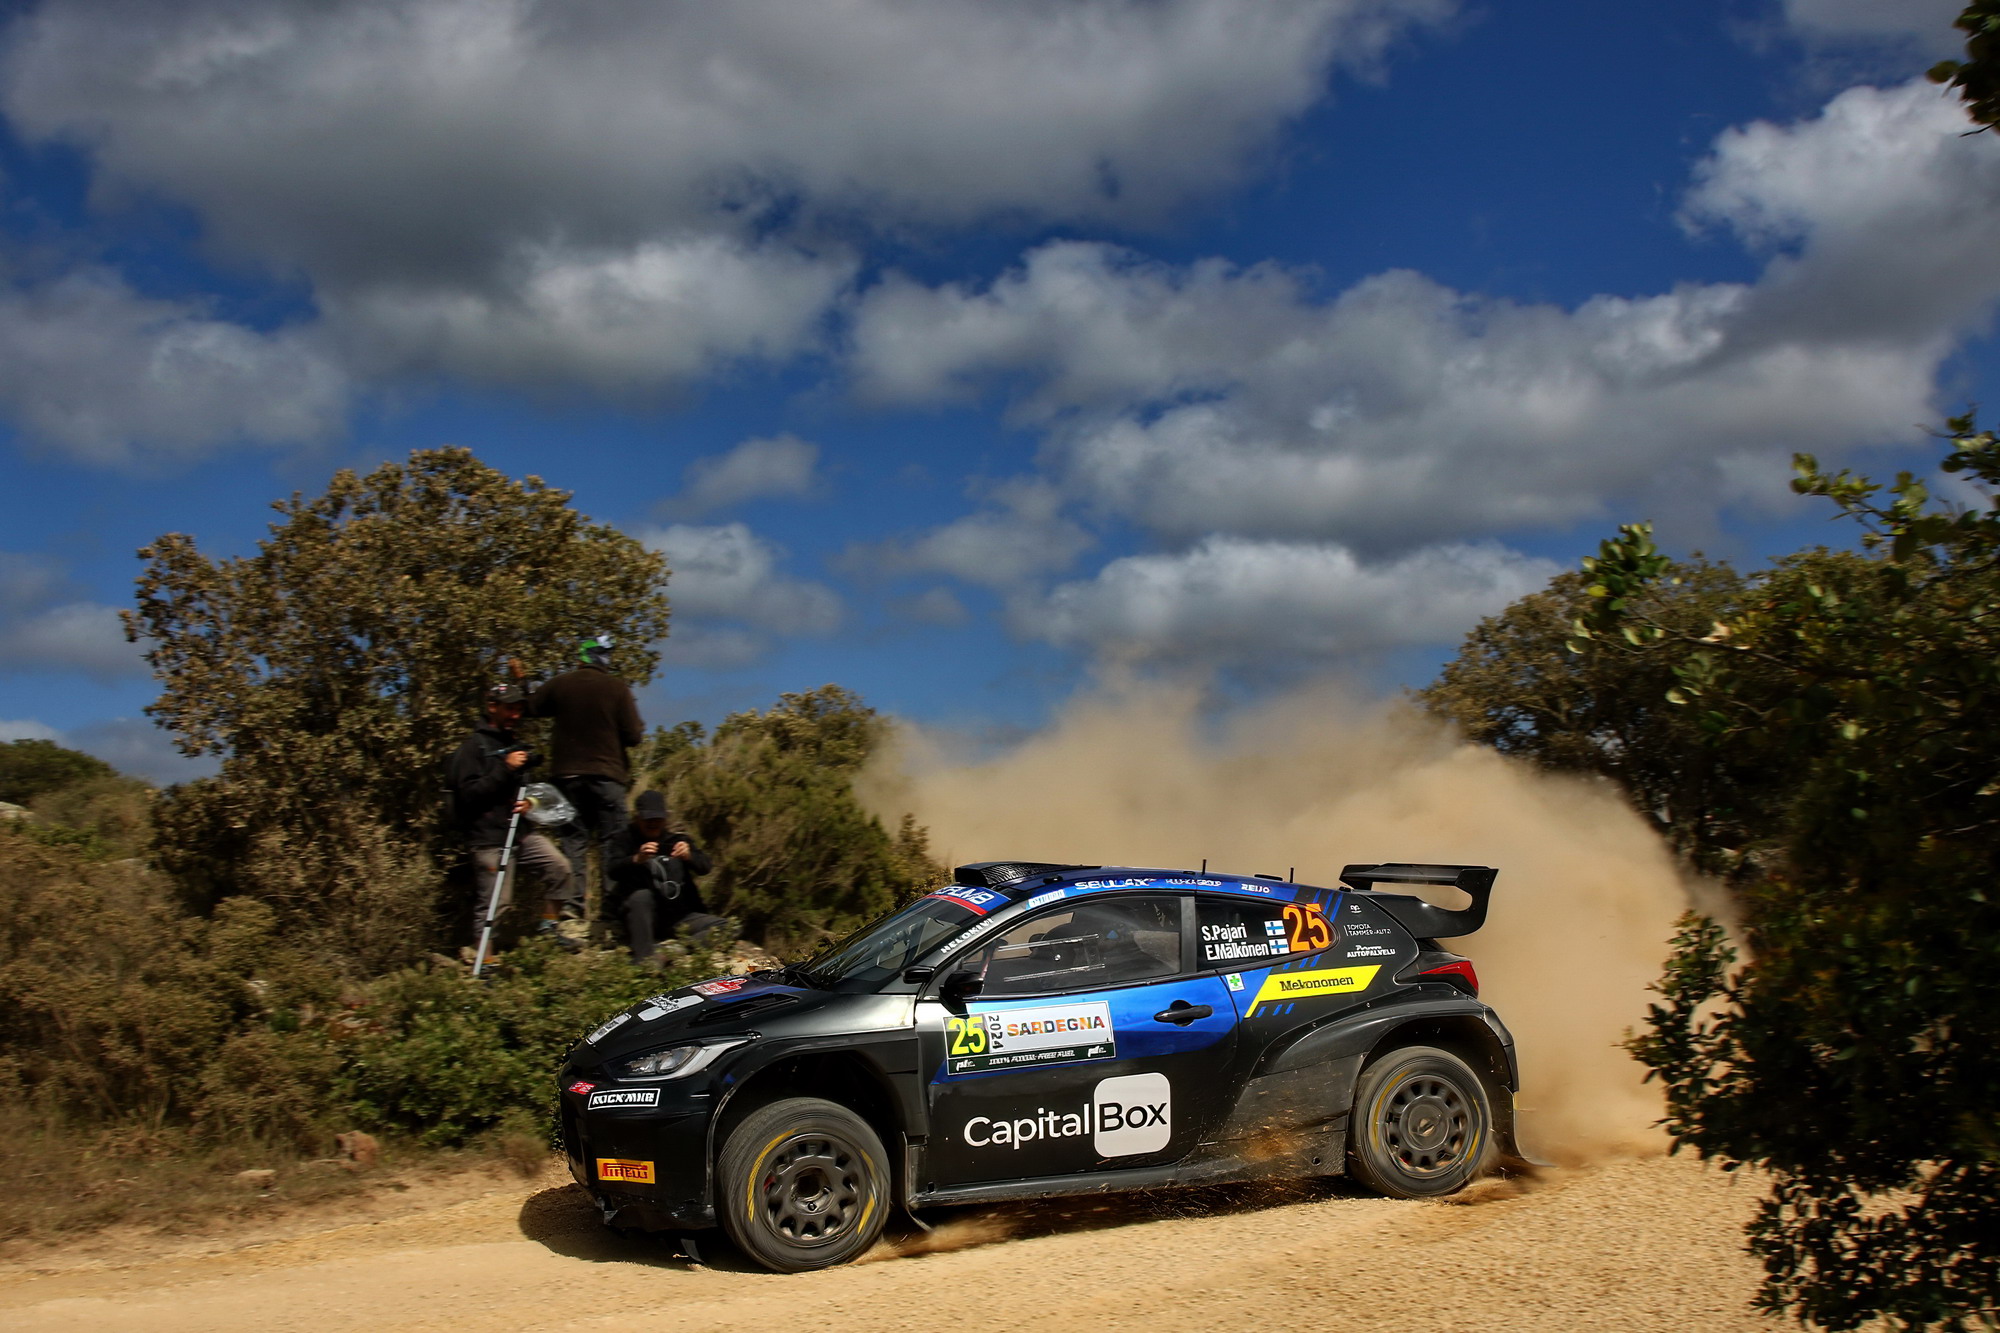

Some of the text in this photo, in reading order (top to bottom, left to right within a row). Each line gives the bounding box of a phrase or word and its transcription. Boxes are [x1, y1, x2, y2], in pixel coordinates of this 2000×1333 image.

[1241, 883, 1270, 894] REIJO
[1201, 922, 1247, 942] S.Pajari
[1283, 903, 1331, 952] 25
[1346, 923, 1371, 931] TOYOTA
[1279, 976, 1354, 992] Mekonomen
[947, 1016, 987, 1055] 25
[988, 1014, 1004, 1050] 2024
[1007, 1016, 1105, 1037] SARDEGNA
